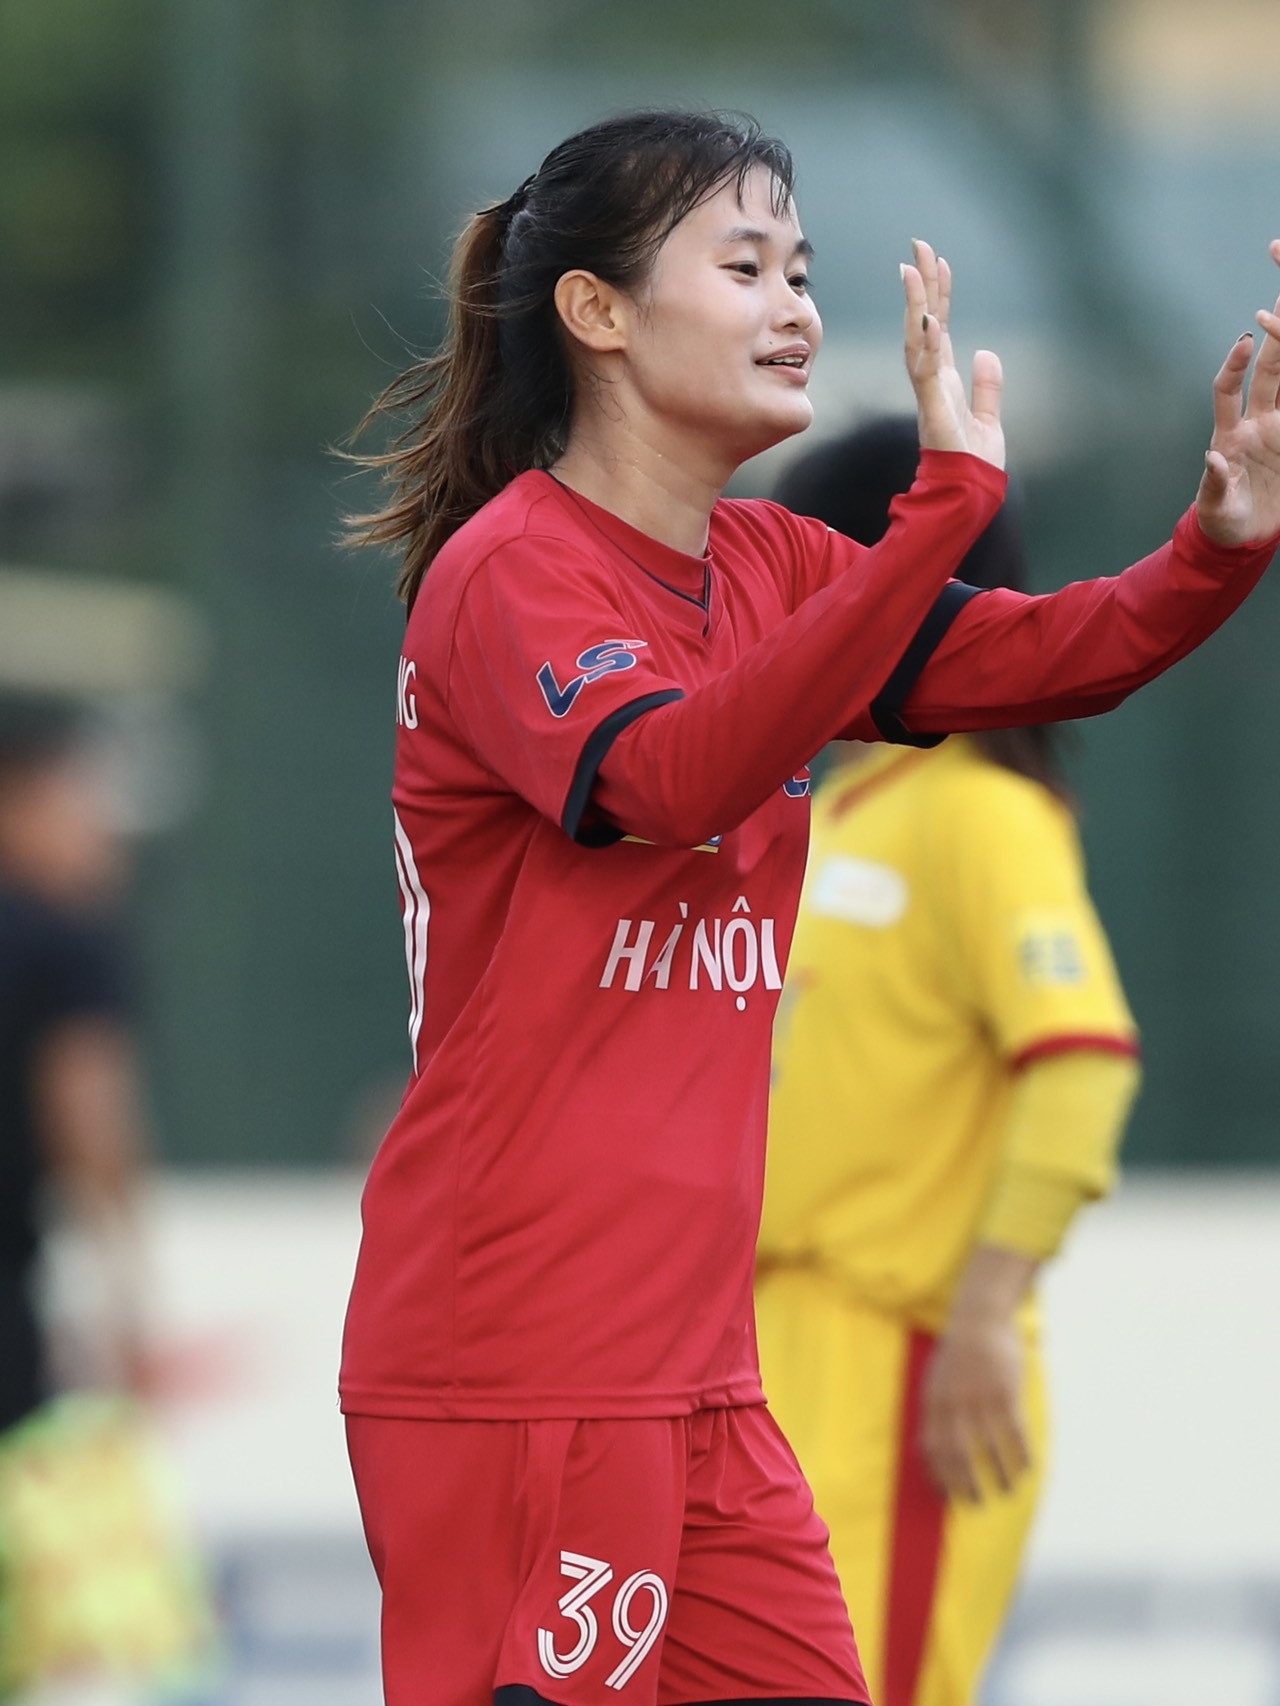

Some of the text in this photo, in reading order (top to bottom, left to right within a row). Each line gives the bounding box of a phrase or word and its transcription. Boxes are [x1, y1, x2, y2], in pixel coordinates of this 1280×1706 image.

[599, 895, 783, 1012] HÀ NỘI
[537, 1550, 669, 1691] 39
